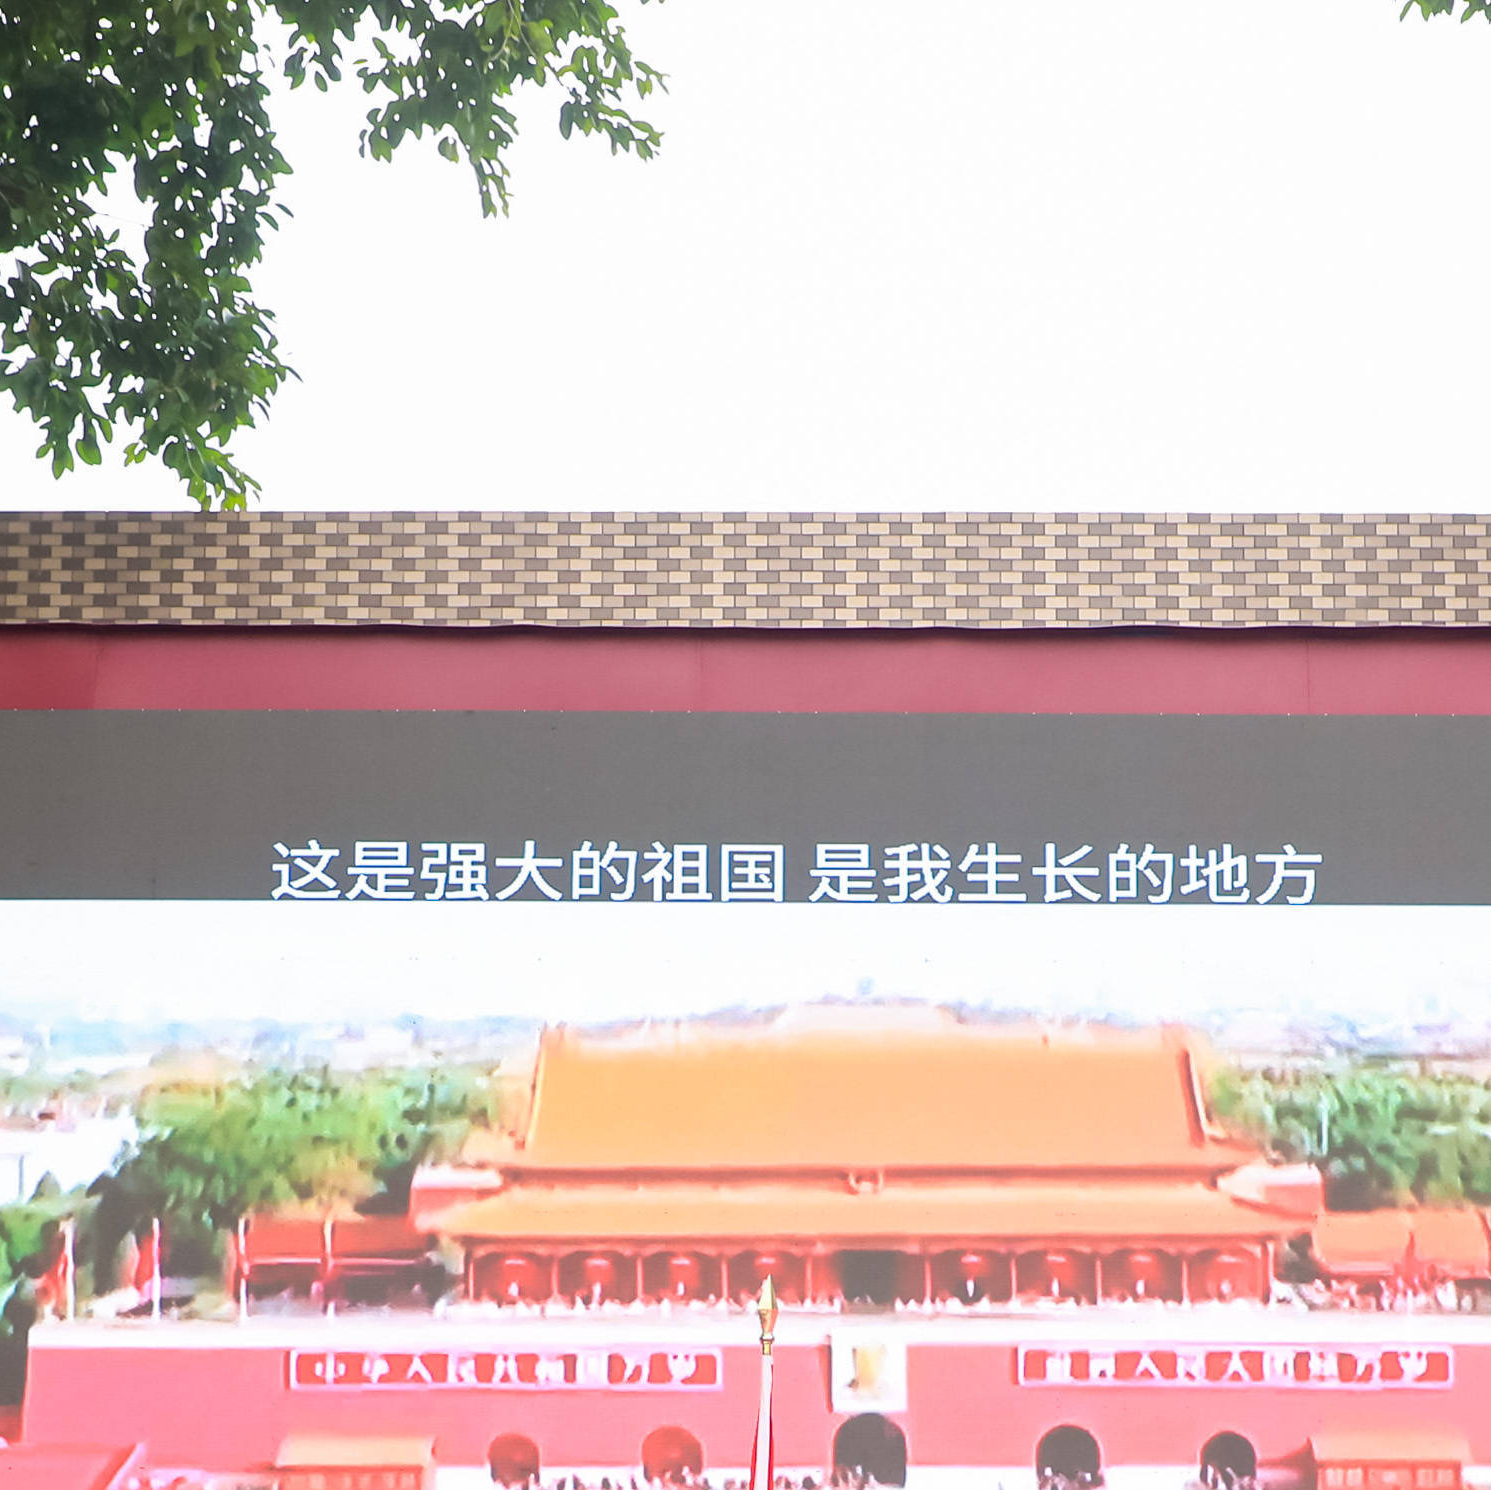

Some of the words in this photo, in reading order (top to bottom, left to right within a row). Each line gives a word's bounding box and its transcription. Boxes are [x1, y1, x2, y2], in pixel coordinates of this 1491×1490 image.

[271, 838, 786, 902] 这是强大的祖国
[808, 841, 1324, 906] 是我生长的地方
